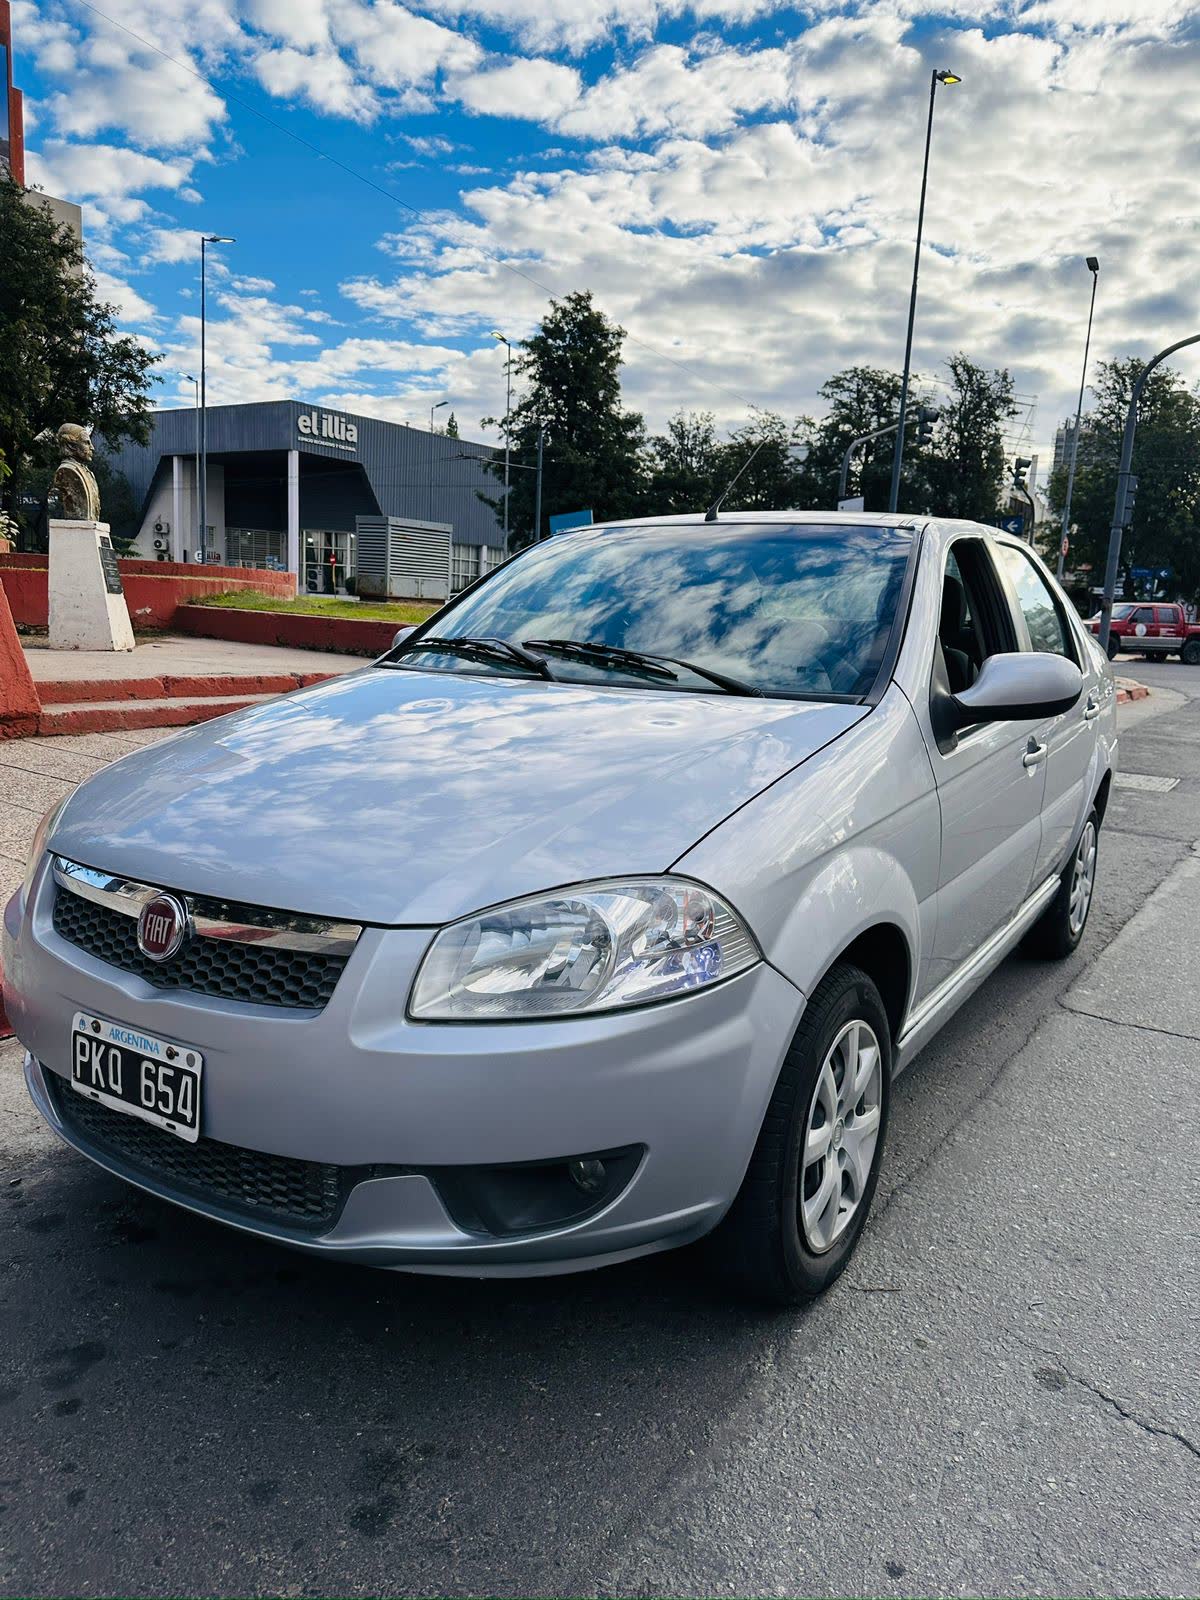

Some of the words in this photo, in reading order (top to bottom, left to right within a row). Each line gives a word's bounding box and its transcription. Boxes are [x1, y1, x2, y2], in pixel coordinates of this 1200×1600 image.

[297, 411, 319, 436] el
[321, 413, 358, 443] illia
[144, 913, 173, 945] FIAT
[109, 1027, 160, 1055] ARGENTINA
[76, 1034, 123, 1095] PKQ
[140, 1060, 193, 1123] 654
